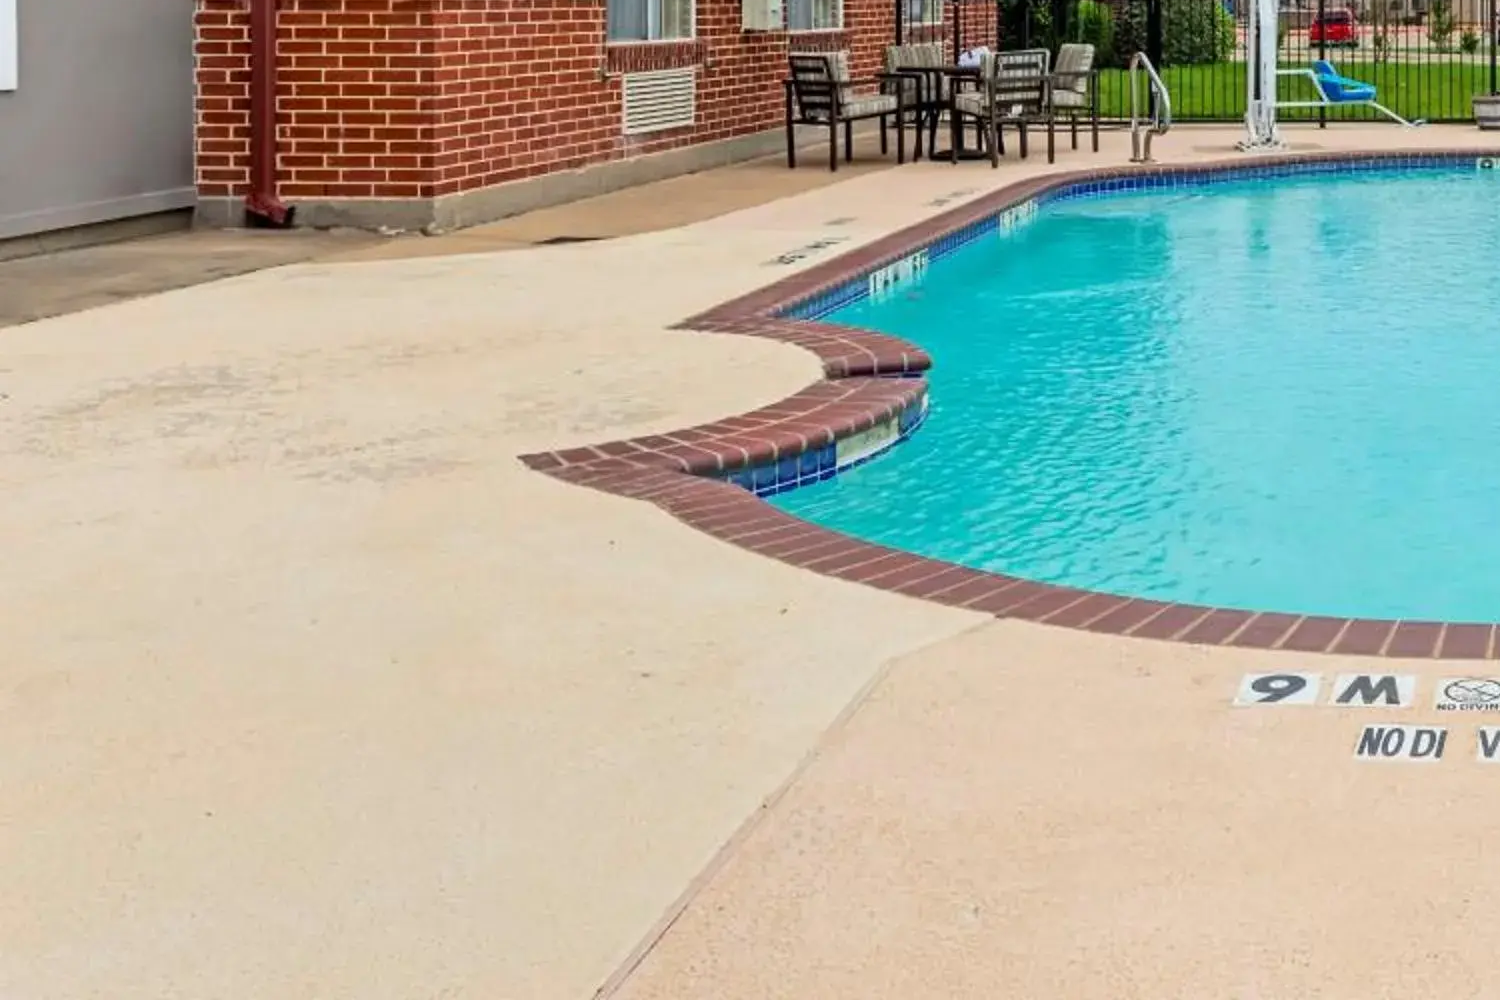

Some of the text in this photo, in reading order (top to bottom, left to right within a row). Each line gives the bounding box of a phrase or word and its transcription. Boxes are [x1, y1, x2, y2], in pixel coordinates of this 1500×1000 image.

[1251, 674, 1307, 703] 9
[1335, 675, 1401, 705] M
[1436, 703, 1457, 712] NO
[1357, 727, 1406, 757] NO
